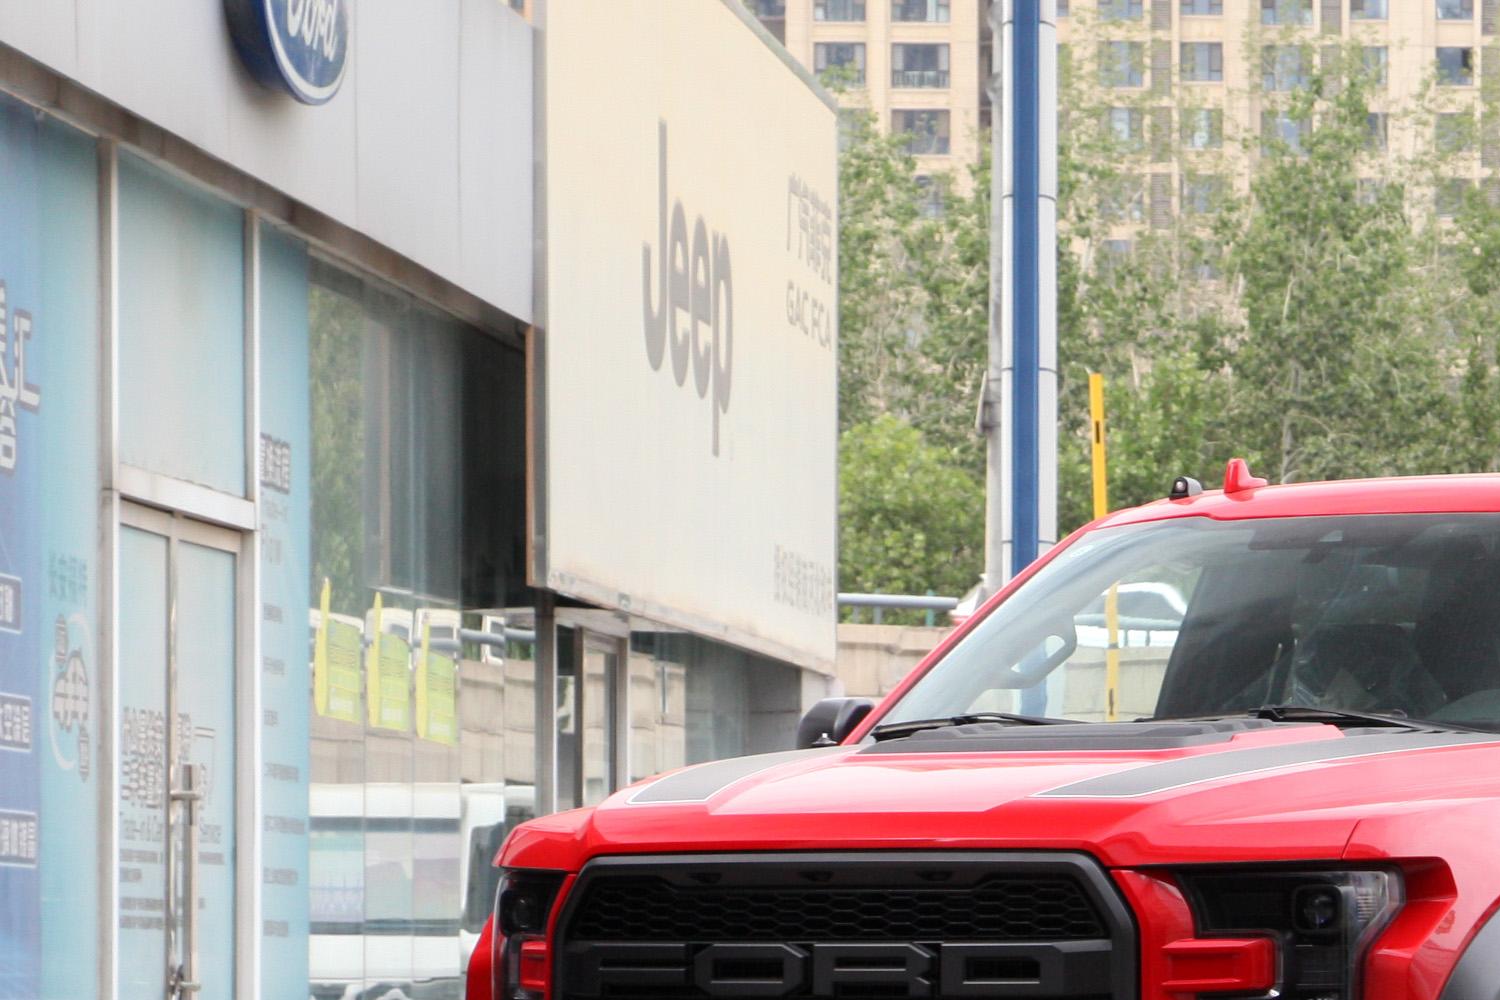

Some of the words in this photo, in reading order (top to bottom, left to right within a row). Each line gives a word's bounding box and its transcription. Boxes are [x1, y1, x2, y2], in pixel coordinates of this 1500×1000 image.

[642, 116, 734, 458] Jeep
[786, 279, 809, 335] GAC
[811, 296, 832, 352] FCA
[572, 940, 1070, 997] FORD
